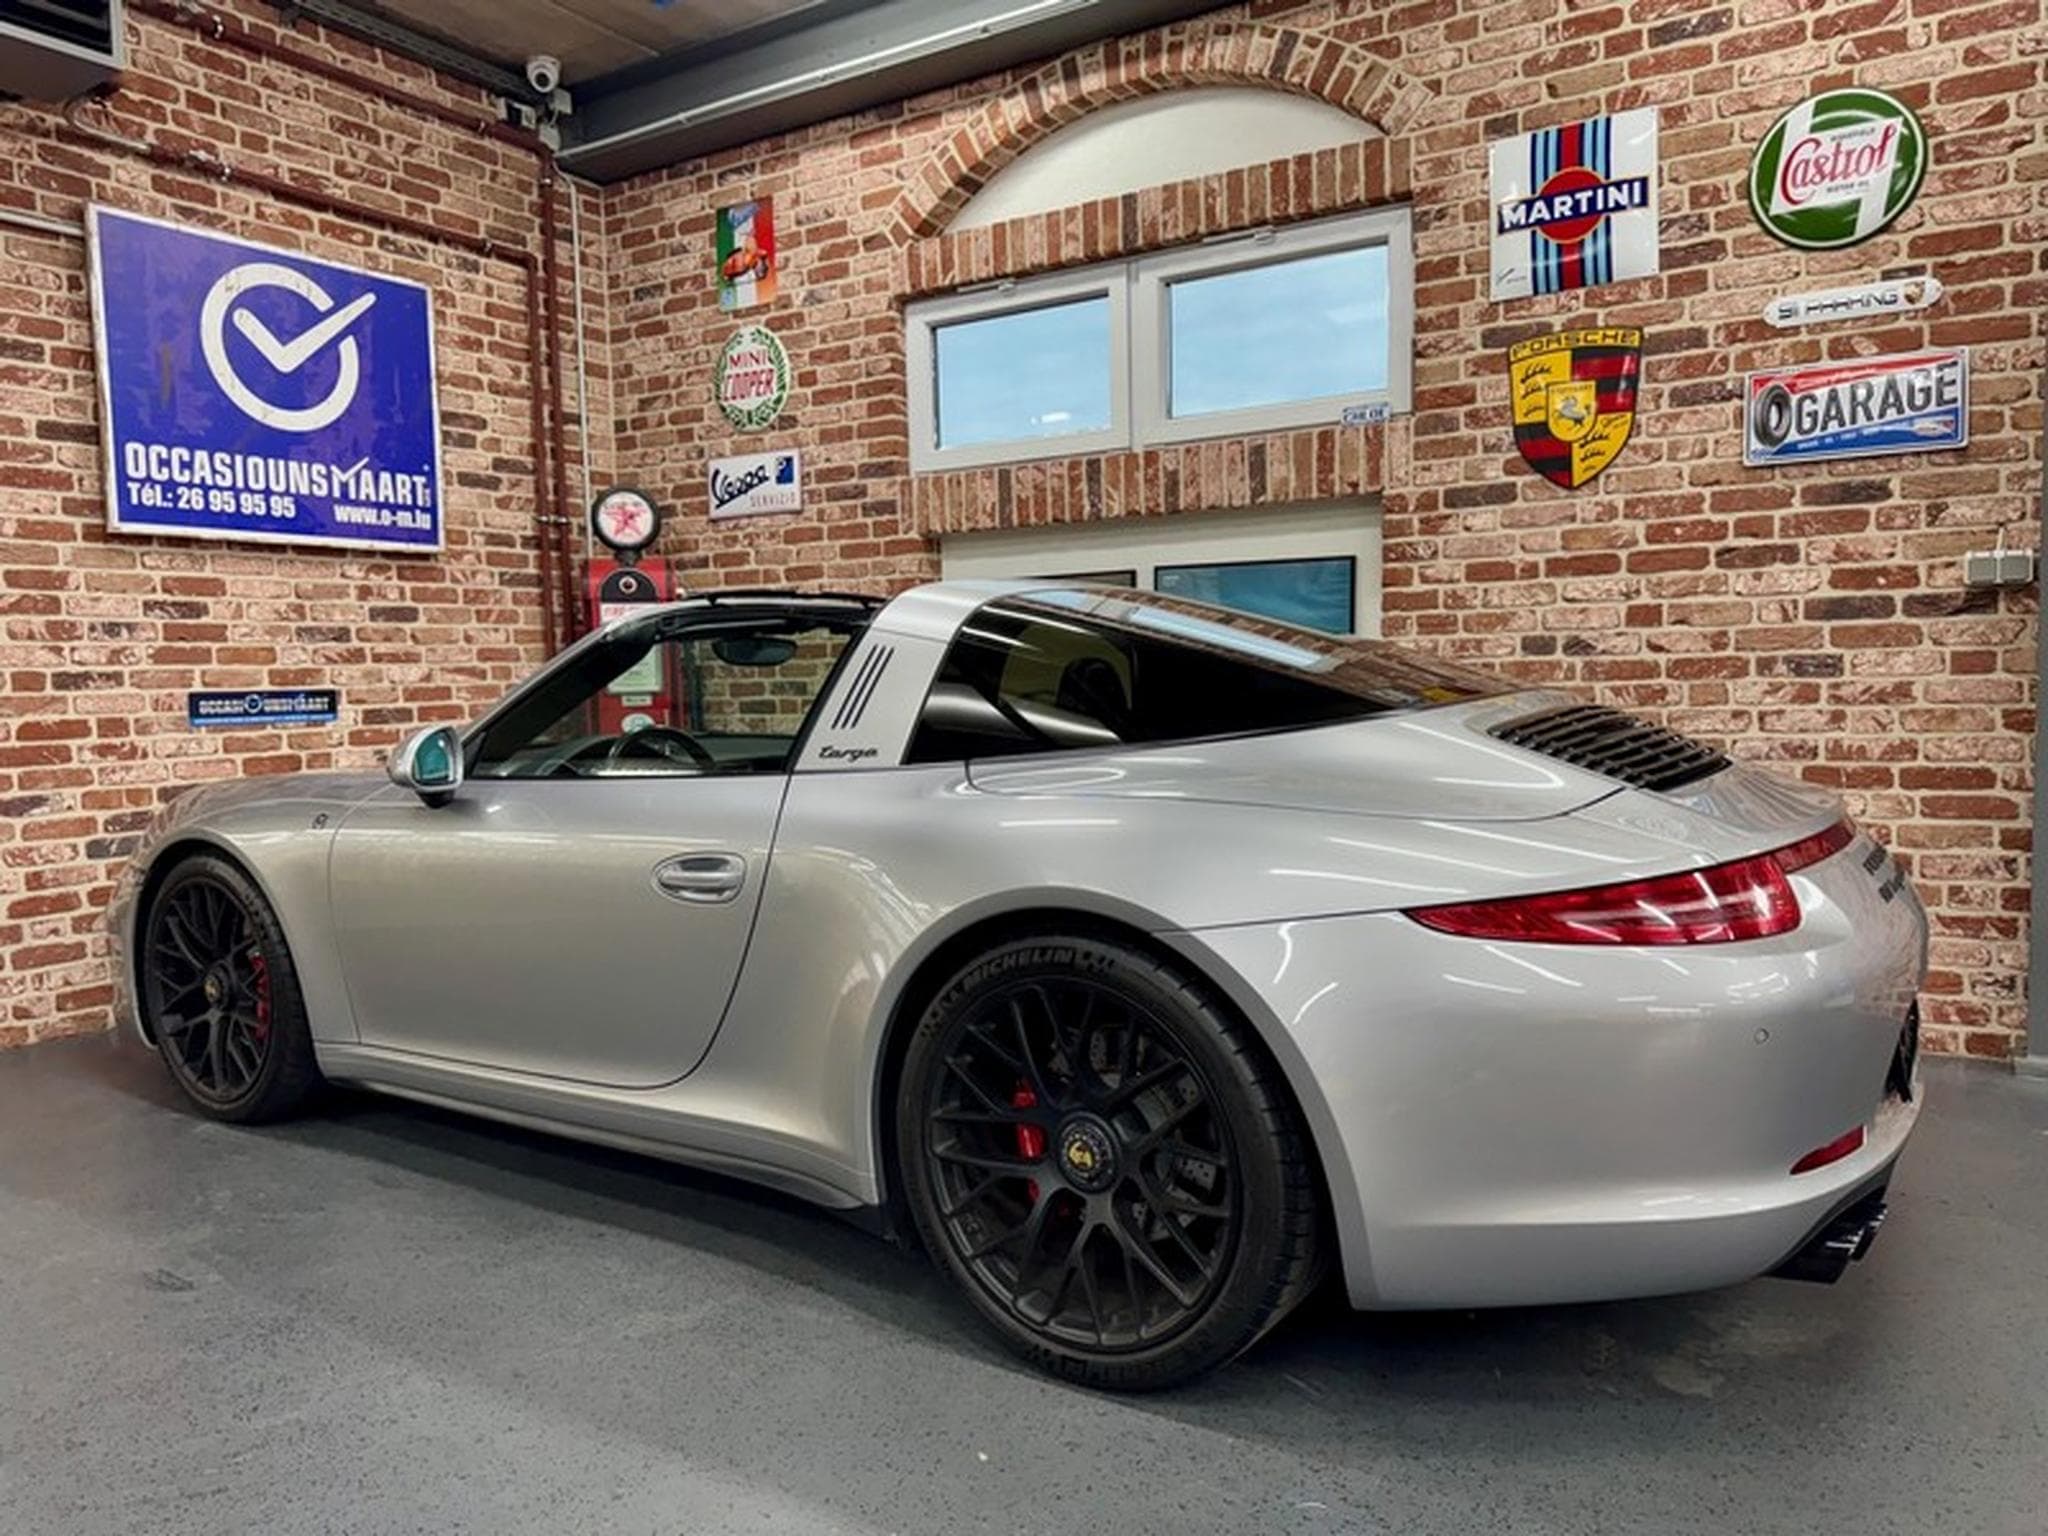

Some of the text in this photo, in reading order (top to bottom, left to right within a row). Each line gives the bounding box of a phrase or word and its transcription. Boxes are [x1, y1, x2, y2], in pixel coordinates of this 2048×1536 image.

[1781, 123, 1897, 205] Castrol
[1501, 180, 1642, 230] MARTINI
[728, 351, 769, 369] MINI
[1513, 330, 1636, 359] PORSCHE
[723, 369, 776, 402] COOPER
[1795, 360, 1960, 436] GARAGE
[177, 485, 204, 511] 26
[208, 490, 236, 514] 95
[240, 492, 267, 516] 95
[270, 495, 296, 518] 95
[711, 465, 770, 510] Vespa
[961, 946, 1075, 991] MICHELIN
